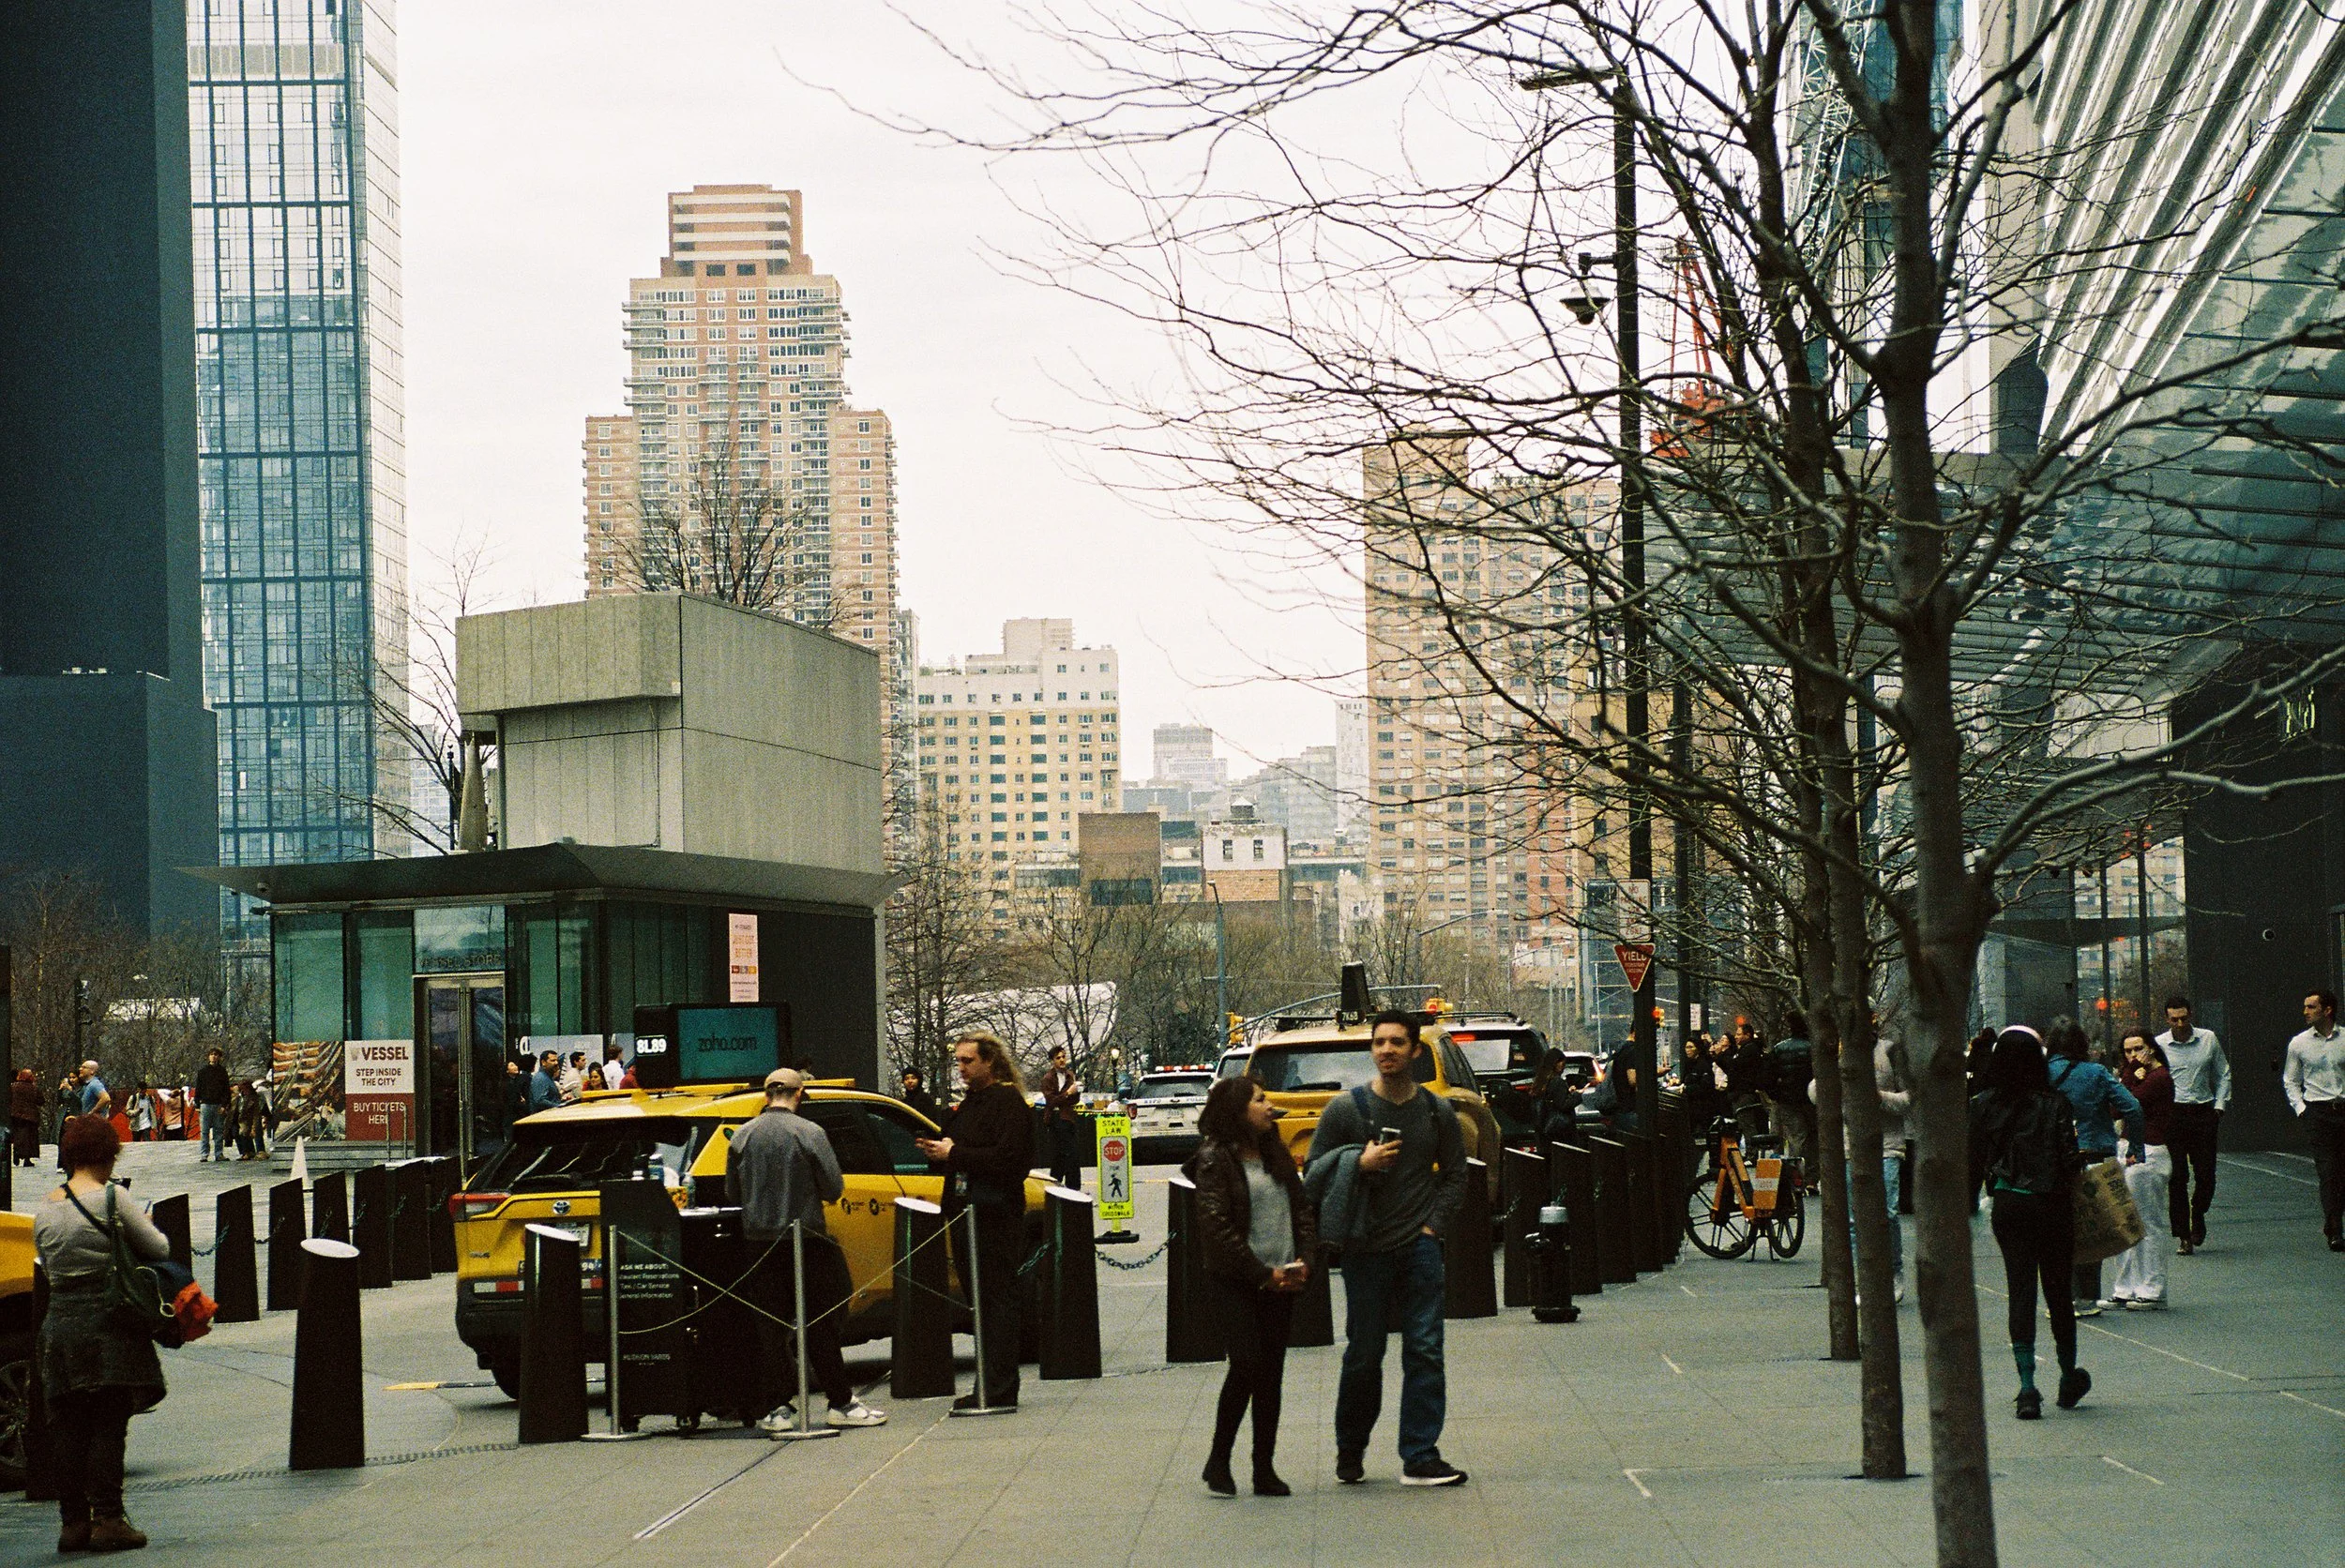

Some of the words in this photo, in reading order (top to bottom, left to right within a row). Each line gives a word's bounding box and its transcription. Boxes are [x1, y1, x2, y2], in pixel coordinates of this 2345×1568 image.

[1622, 951, 1647, 961] YIELD
[418, 957, 461, 969] VESSEL
[464, 955, 501, 967] STORE
[636, 1038, 667, 1053] 8L89
[697, 1034, 757, 1051] zoho.com
[361, 1047, 409, 1061] VESSEL
[356, 1068, 374, 1077] STEP
[376, 1068, 401, 1077] INSIDE
[361, 1078, 375, 1086] THE
[377, 1078, 396, 1086] CITY
[354, 1102, 371, 1112] BUY
[371, 1102, 405, 1112] TICKETS
[1104, 1146, 1124, 1156] STOP
